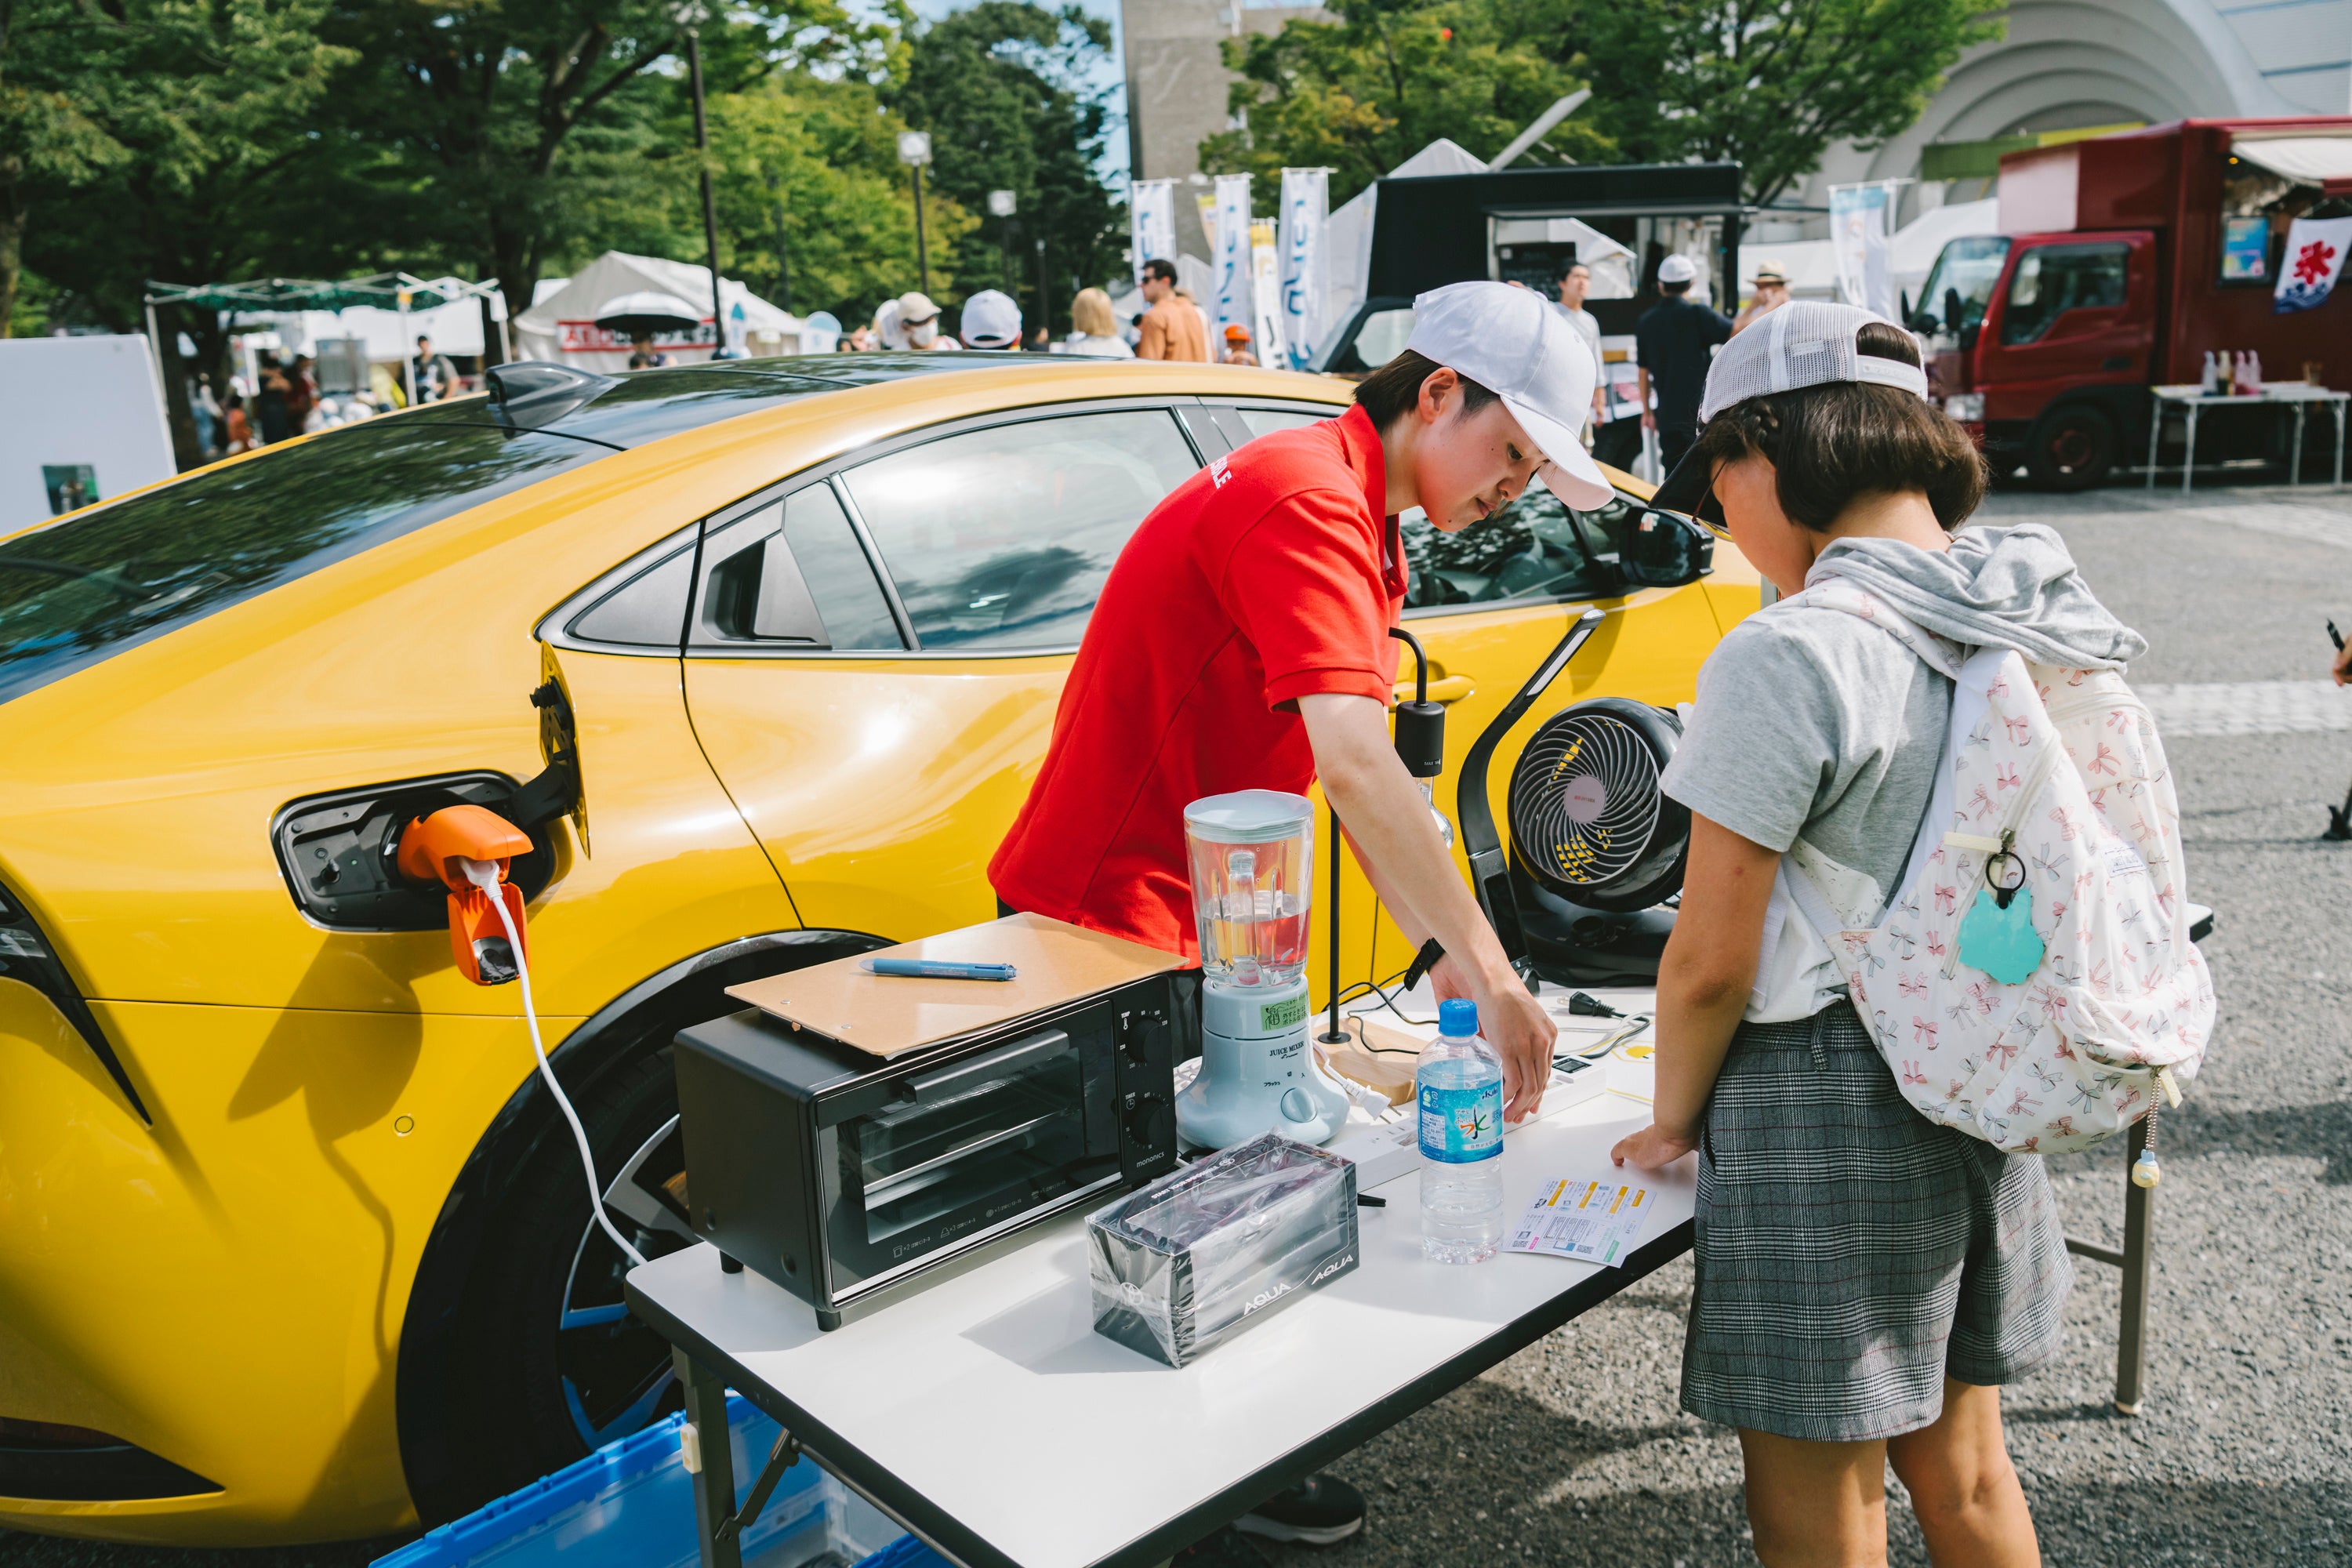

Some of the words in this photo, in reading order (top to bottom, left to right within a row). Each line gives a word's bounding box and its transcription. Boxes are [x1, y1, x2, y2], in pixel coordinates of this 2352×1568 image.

[1269, 1047, 1287, 1056] JUICE
[1289, 1040, 1305, 1051] MIXER
[1482, 1086, 1498, 1100] Asahi
[1460, 1105, 1490, 1139] 水
[1136, 1151, 1165, 1168] mononics
[1312, 1254, 1354, 1286] AQUA
[1243, 1283, 1292, 1316] AQUA
